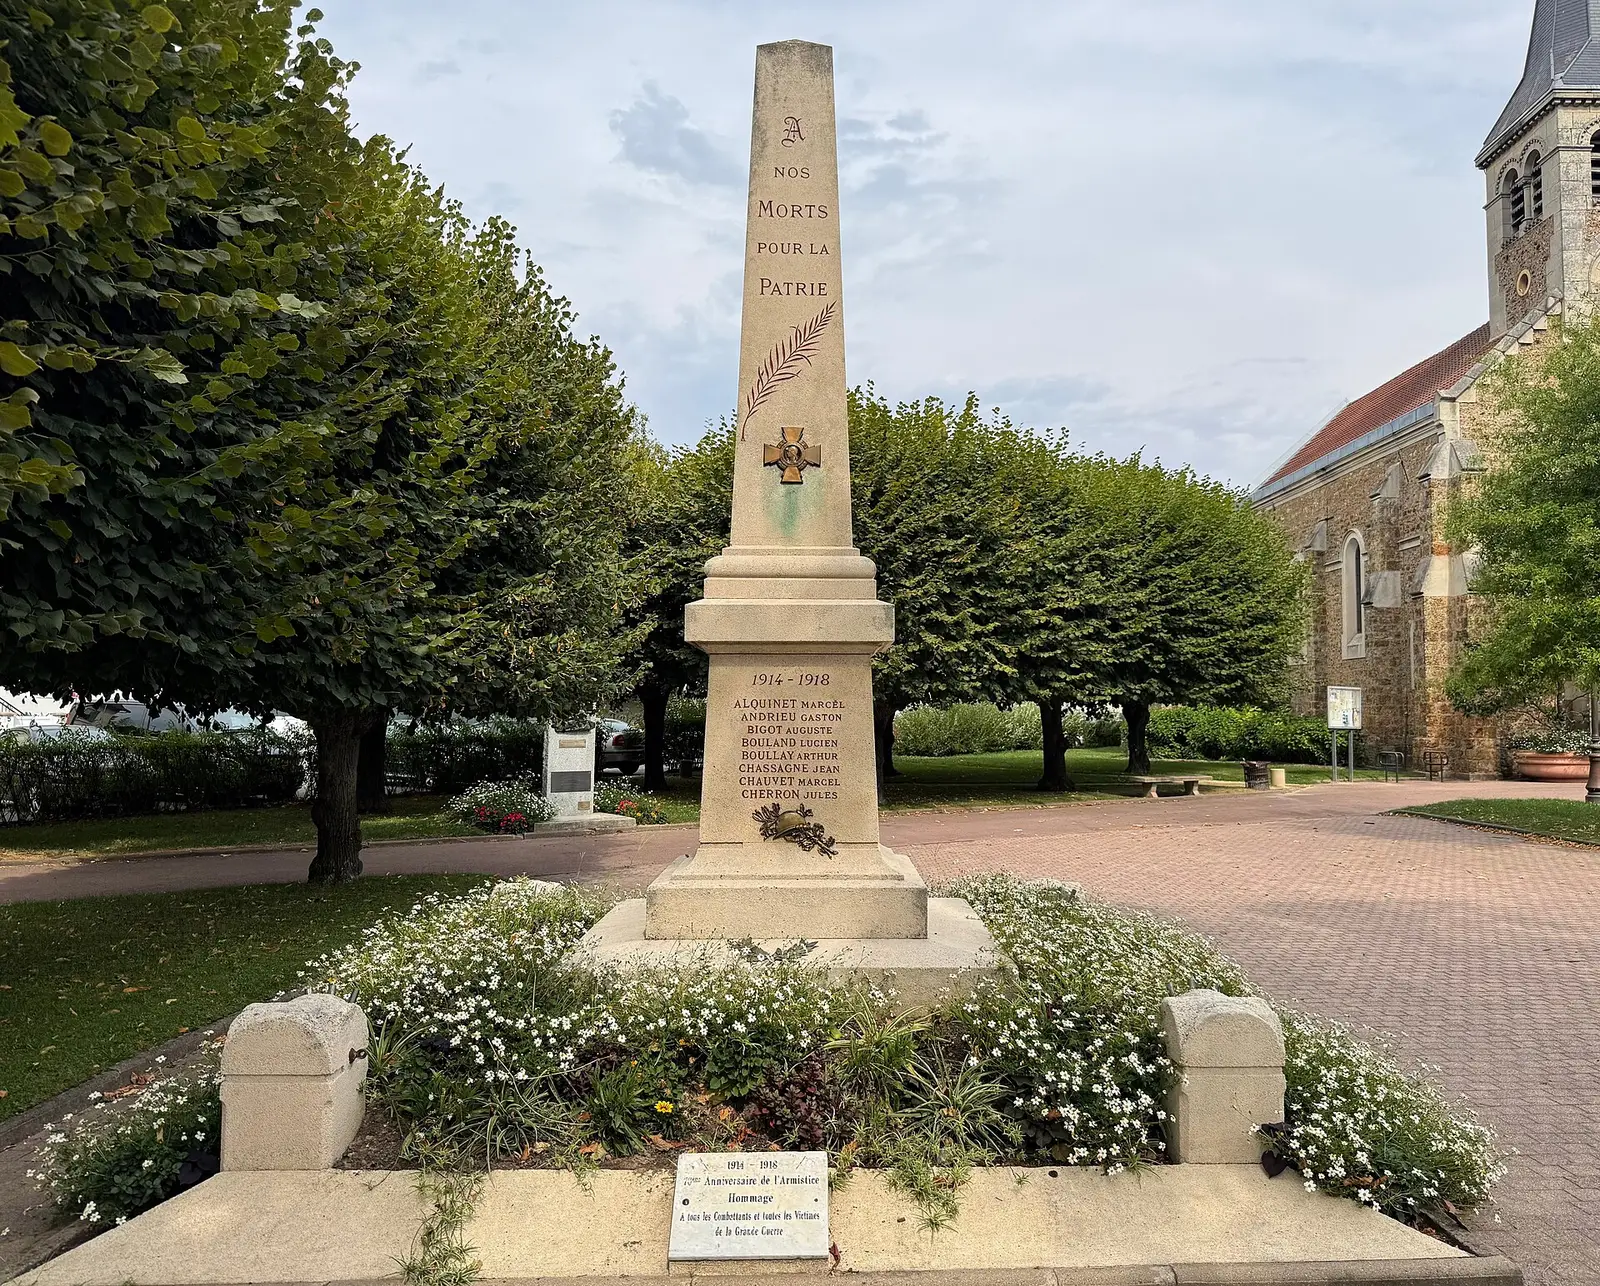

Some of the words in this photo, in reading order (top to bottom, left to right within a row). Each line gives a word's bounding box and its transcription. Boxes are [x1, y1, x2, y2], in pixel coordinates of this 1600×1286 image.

[781, 116, 806, 148] A
[773, 167, 810, 179] NOS
[758, 200, 829, 219] MORTS
[757, 242, 804, 255] POUR
[810, 243, 830, 255] LA
[759, 278, 828, 296] PATRIE
[734, 699, 797, 709] ALQUINET
[741, 712, 796, 721] ANDRIEU
[747, 726, 782, 734] BIGOT
[786, 726, 833, 734] AUGUSTE
[742, 738, 796, 747] BOULAND
[742, 751, 794, 760] BOULLAY
[796, 752, 838, 760] ARTHUR
[738, 764, 808, 773] CHASSAGNE
[812, 765, 840, 773] JEAN
[739, 777, 794, 786] CHAUVET
[798, 778, 840, 786] MARCEL
[742, 790, 800, 799] CHERRON
[803, 791, 838, 799] JULES
[704, 1175, 757, 1186] Anniversaire
[760, 1175, 771, 1185] de
[728, 1193, 774, 1204] Hommage
[702, 1211, 711, 1221] les
[754, 1212, 760, 1221] et
[762, 1212, 781, 1220] toutes
[783, 1211, 792, 1220] les
